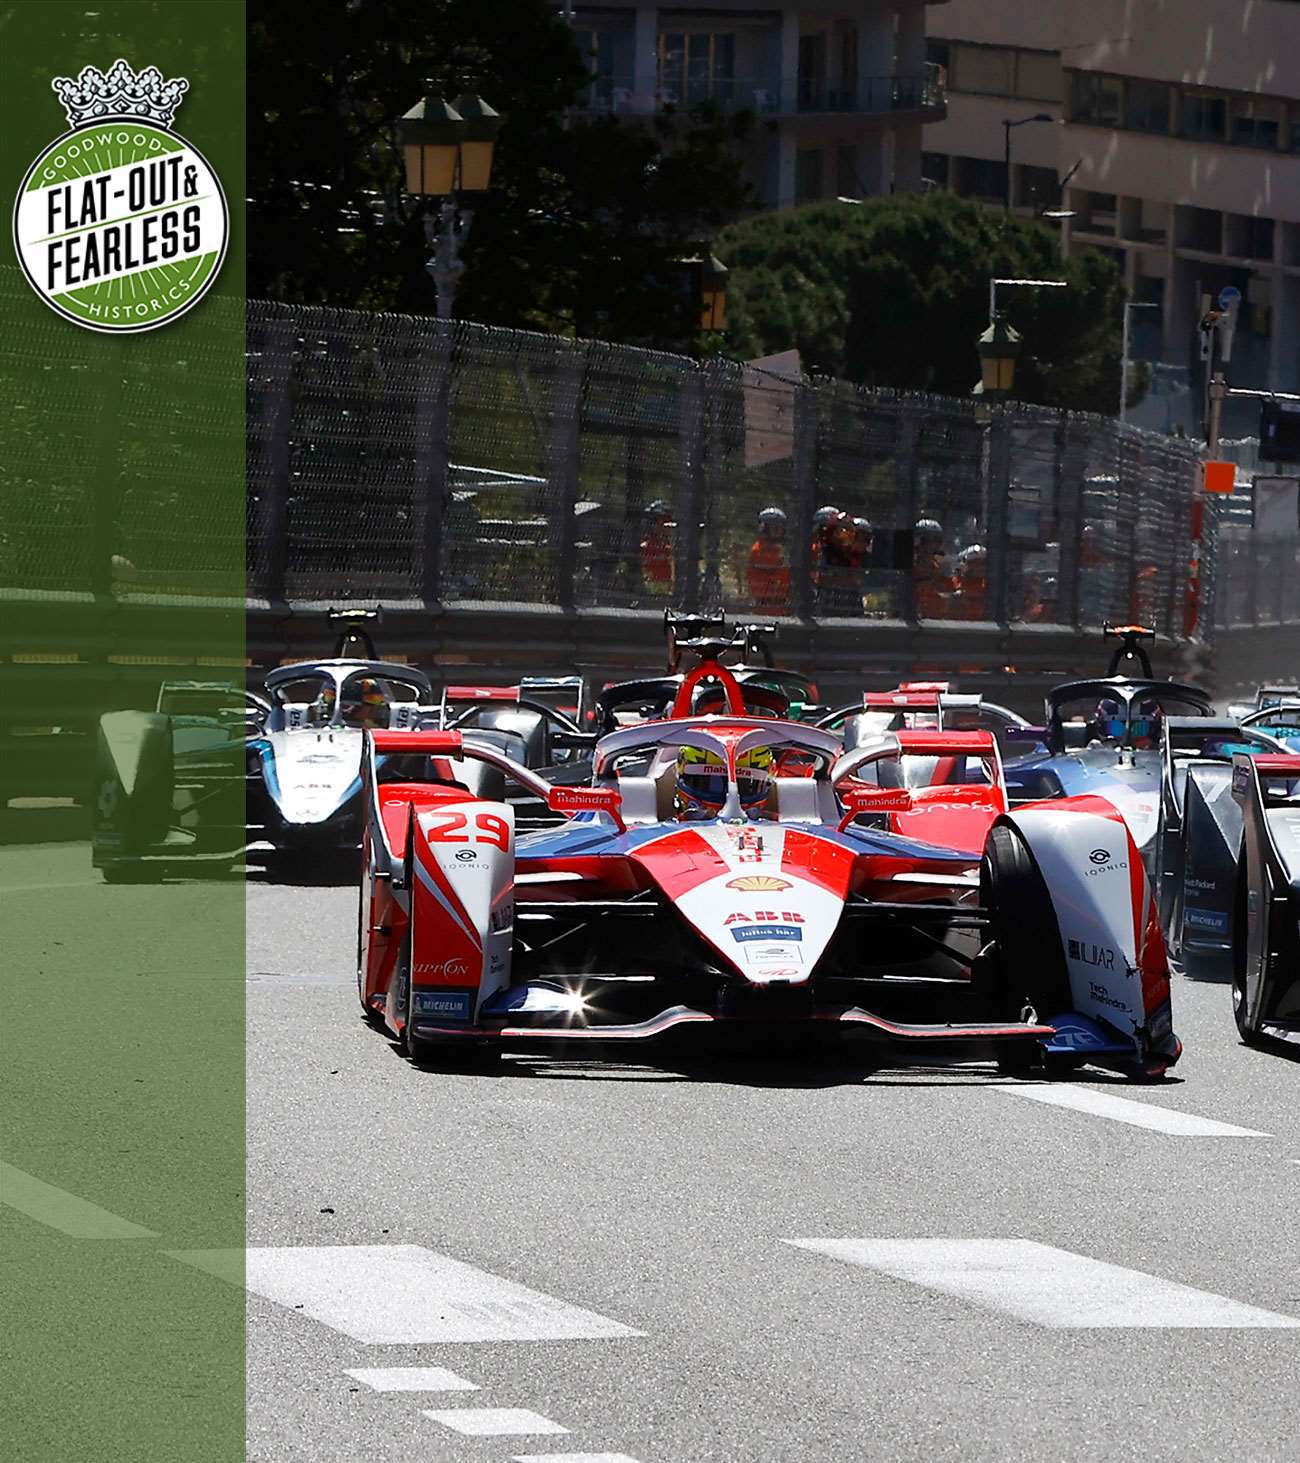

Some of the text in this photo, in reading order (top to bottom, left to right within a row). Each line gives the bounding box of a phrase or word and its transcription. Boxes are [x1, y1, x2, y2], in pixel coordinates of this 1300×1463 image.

[428, 812, 509, 853] 29
[723, 911, 805, 925] ABB
[422, 998, 464, 1011] MICHELIN
